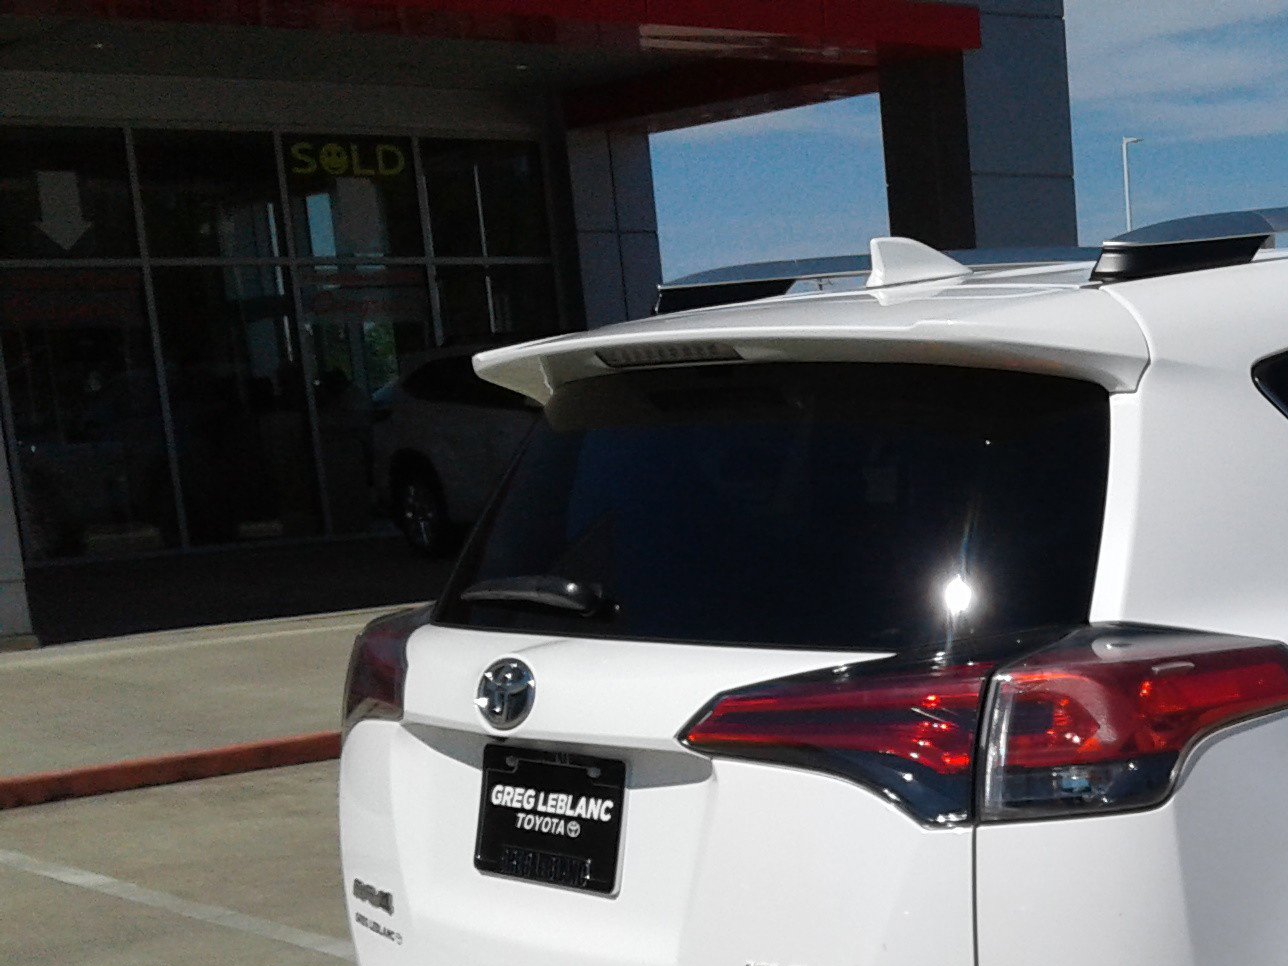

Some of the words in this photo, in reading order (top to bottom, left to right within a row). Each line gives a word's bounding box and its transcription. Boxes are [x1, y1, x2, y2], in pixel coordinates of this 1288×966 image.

[491, 784, 535, 810] GREG
[537, 791, 614, 822] LEBLANC
[516, 813, 565, 836] TOYOTA
